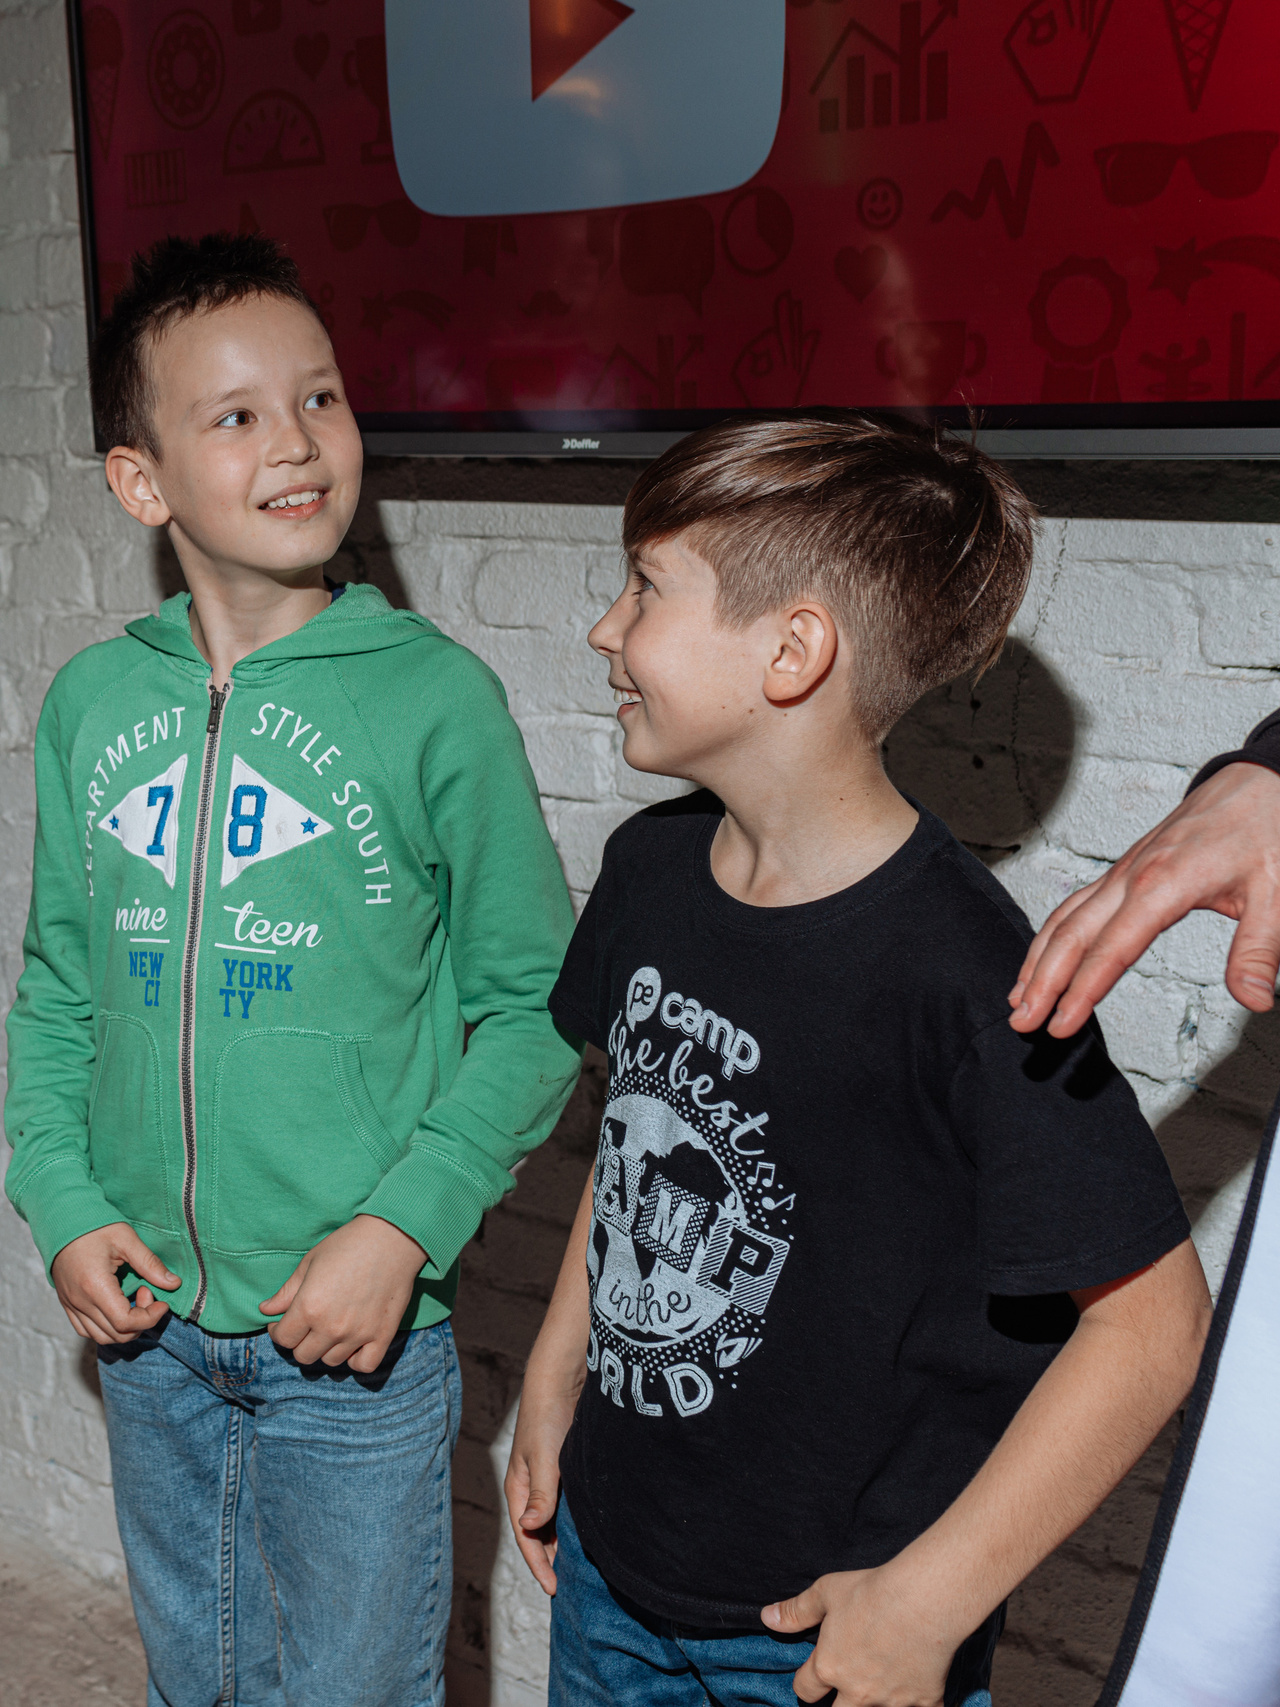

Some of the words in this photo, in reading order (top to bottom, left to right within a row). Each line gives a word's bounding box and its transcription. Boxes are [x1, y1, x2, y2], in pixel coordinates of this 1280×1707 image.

[146, 785, 174, 856] 7
[227, 784, 268, 857] 8
[250, 702, 342, 776] STYLE
[332, 779, 392, 905] SOUTH
[115, 898, 168, 932] nine
[223, 900, 324, 948] teen
[129, 951, 164, 978] NEW
[222, 958, 293, 992] YORK
[144, 980, 160, 1007] CI
[219, 988, 256, 1019] TY
[660, 992, 761, 1081] camp
[669, 1039, 770, 1156] best
[586, 1325, 714, 1418] ORLD
